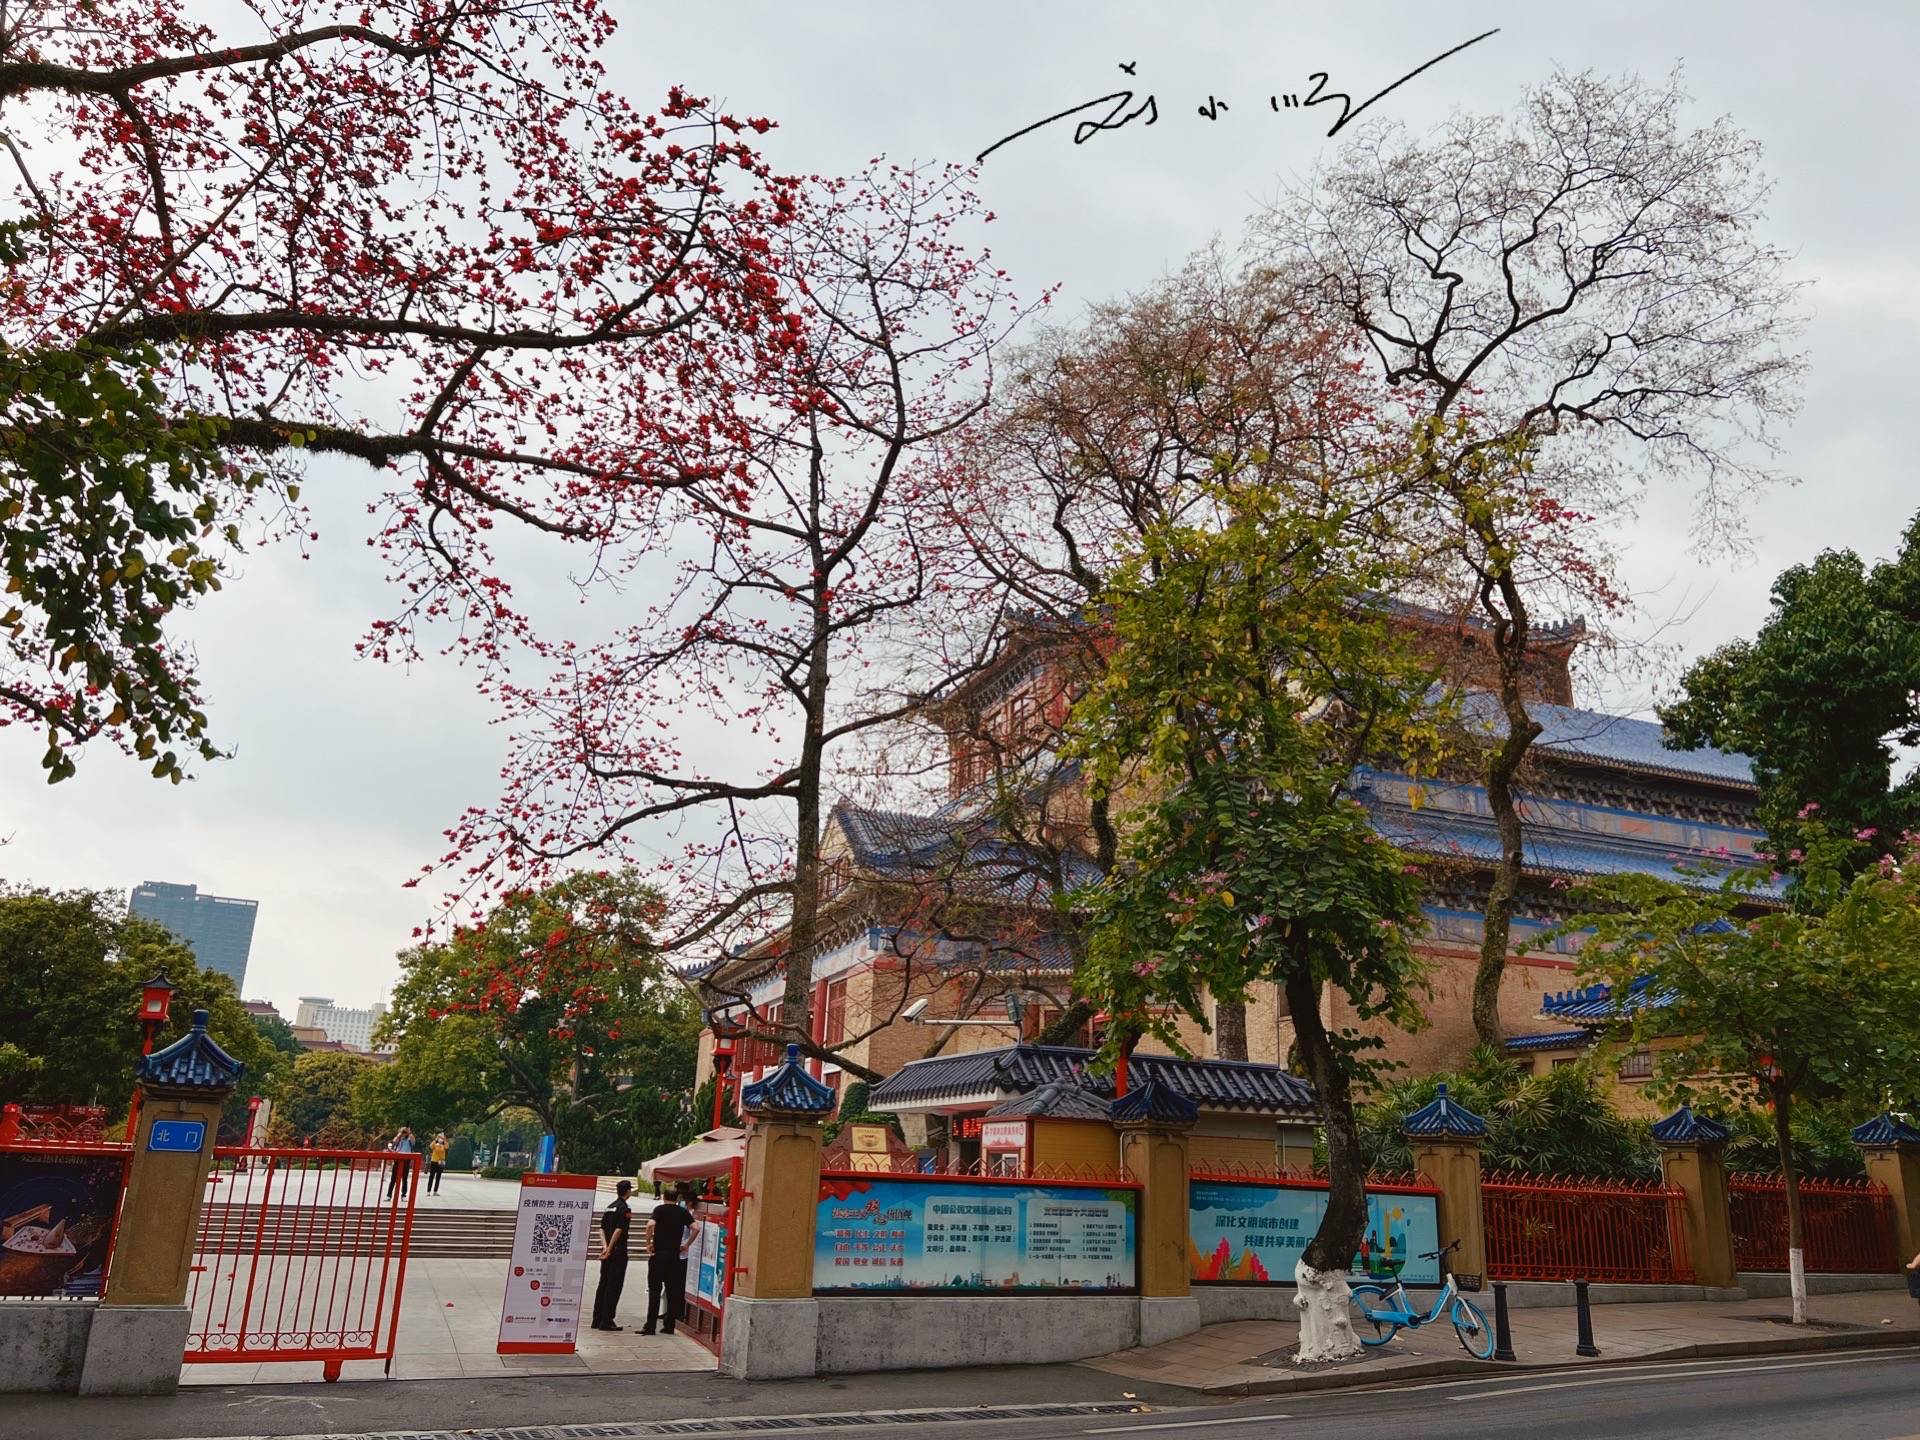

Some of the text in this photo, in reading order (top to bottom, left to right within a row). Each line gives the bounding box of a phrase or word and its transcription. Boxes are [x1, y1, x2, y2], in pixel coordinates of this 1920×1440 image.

[157, 1128, 198, 1143] 北门
[523, 1199, 589, 1210] 疫情防控 扫码入园
[1215, 1215, 1299, 1230] 深化文明城市创建
